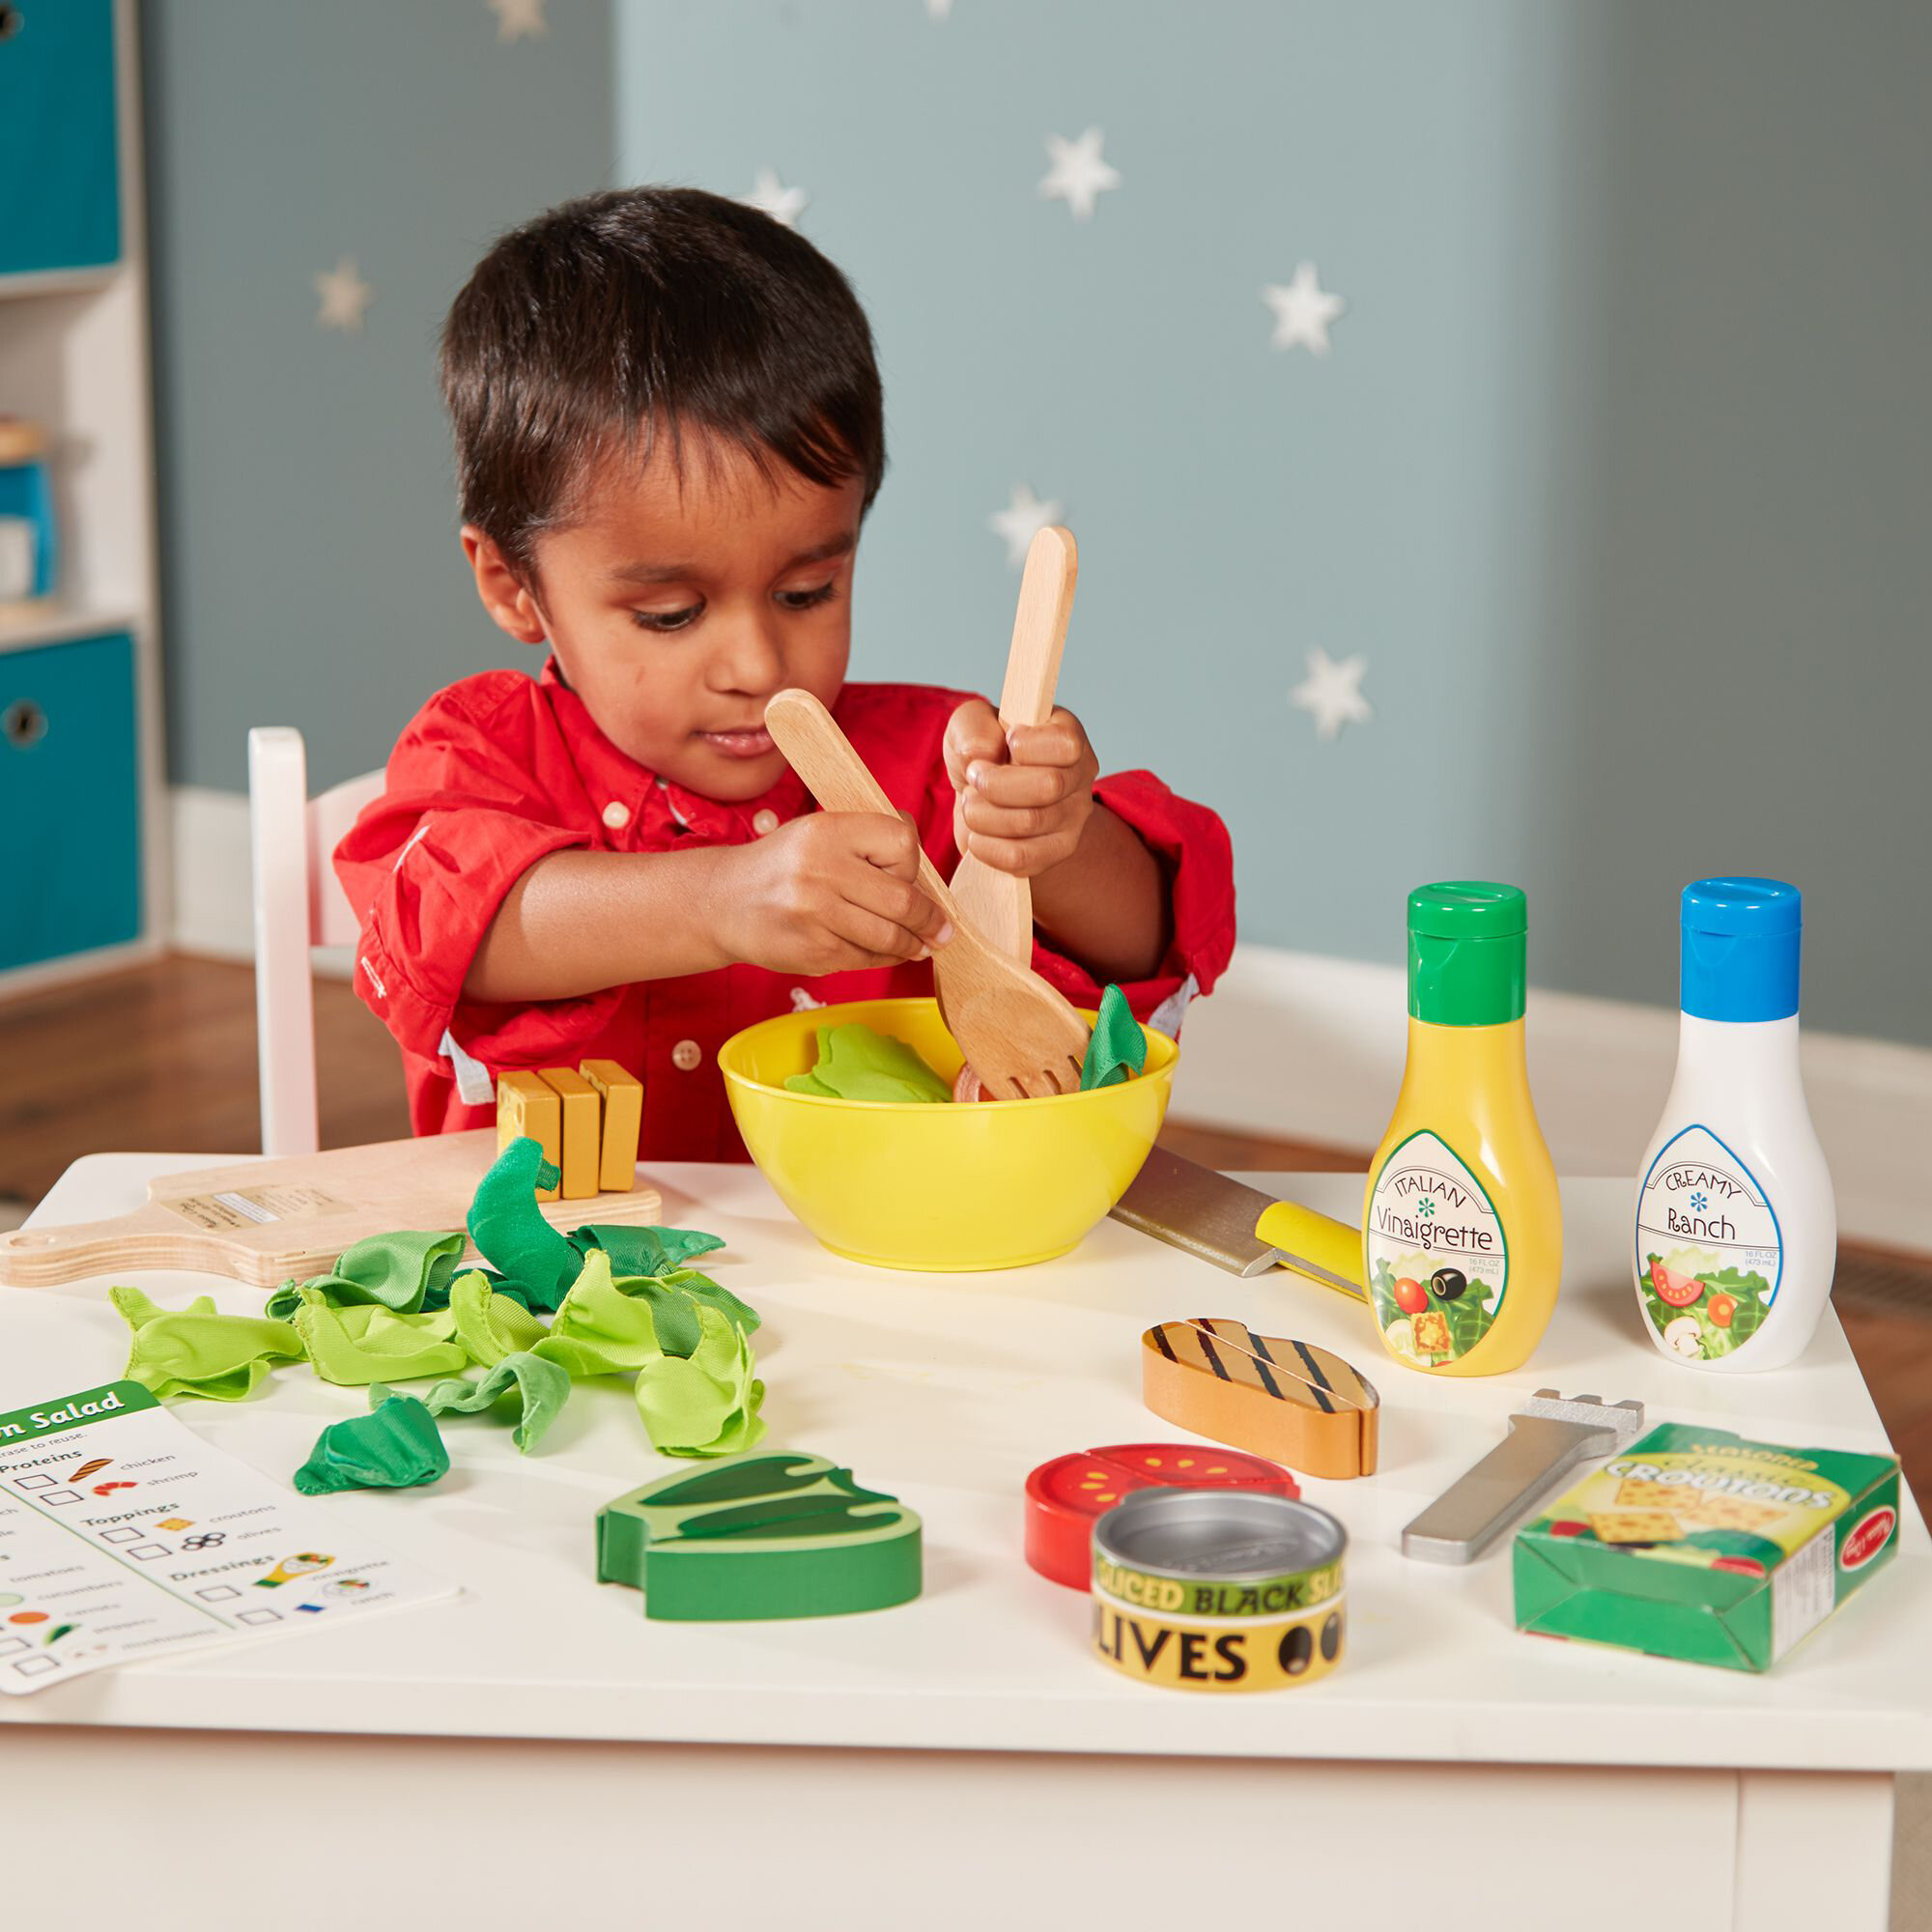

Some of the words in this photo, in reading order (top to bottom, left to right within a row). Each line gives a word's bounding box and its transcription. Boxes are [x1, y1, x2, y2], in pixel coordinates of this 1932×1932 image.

[1395, 1176, 1466, 1208] ITALIAN
[1665, 1170, 1742, 1199] CREAMY
[1377, 1205, 1492, 1250] Vinaigrette
[1667, 1207, 1736, 1240] Ranch
[0, 1422, 26, 1438] n
[30, 1391, 126, 1430] Salad
[0, 1447, 29, 1459] rase
[30, 1441, 45, 1450] to
[48, 1433, 88, 1445] reuse.
[0, 1451, 82, 1473] Proteins
[120, 1454, 177, 1470] chicken
[147, 1471, 198, 1487] shrimp
[80, 1502, 180, 1527] Toppings
[209, 1504, 276, 1523] croutons
[237, 1526, 282, 1541] olives
[169, 1554, 275, 1582] Dressings
[1194, 1580, 1305, 1614] BLACK
